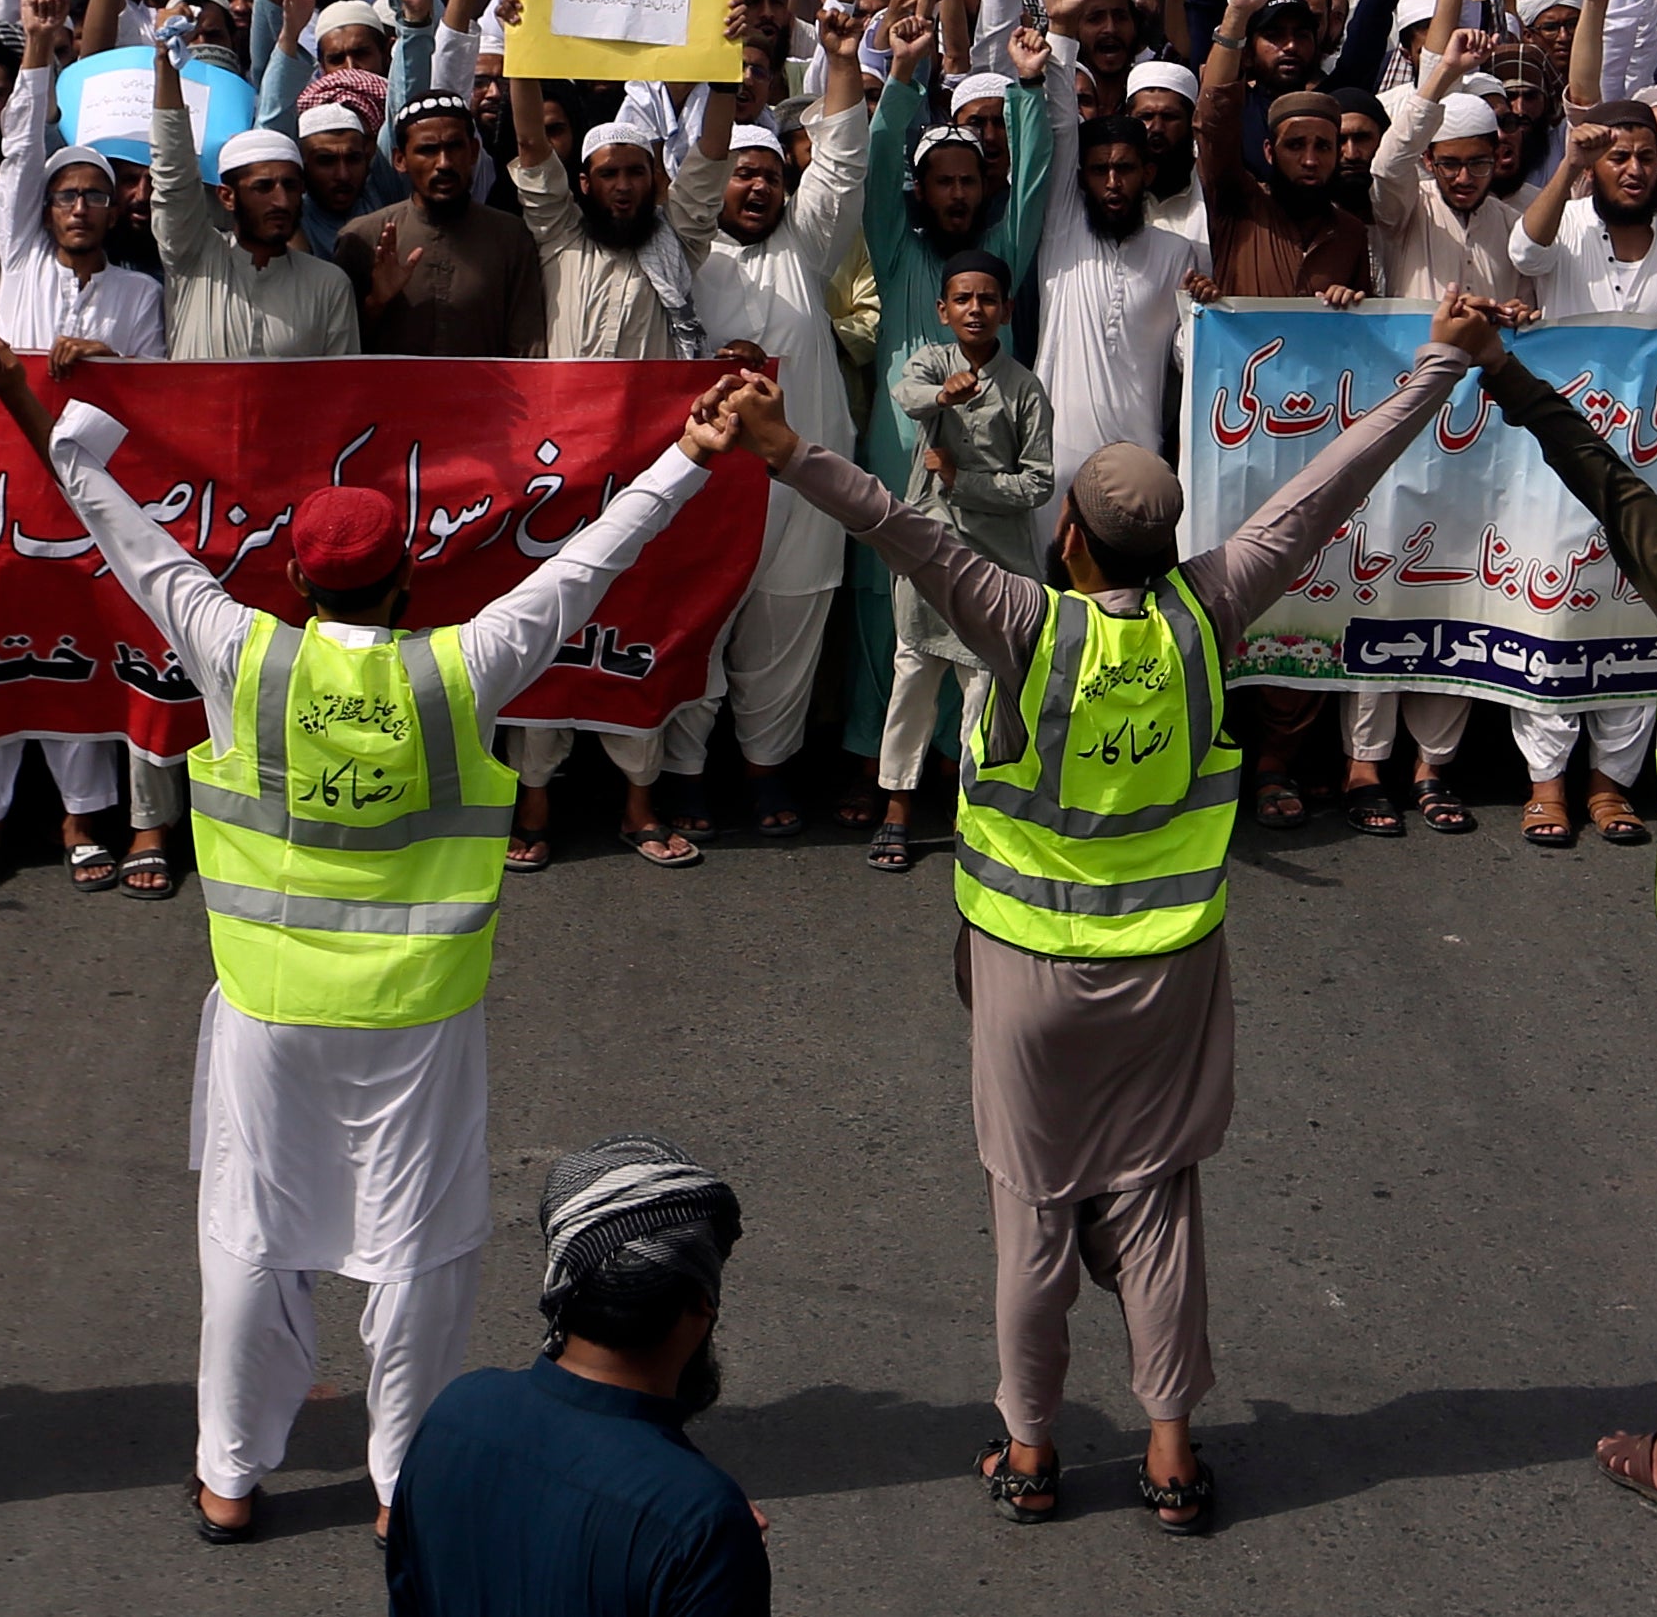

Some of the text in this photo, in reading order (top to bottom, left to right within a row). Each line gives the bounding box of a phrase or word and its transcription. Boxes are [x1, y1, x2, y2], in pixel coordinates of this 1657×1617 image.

[1210, 336, 1284, 450] کی
[1394, 521, 1523, 601] بنائے
[1359, 623, 1490, 672] کراچی
[1492, 641, 1588, 687] نبوت
[1076, 715, 1175, 766] رضا کار
[297, 756, 409, 810] رضا کار
